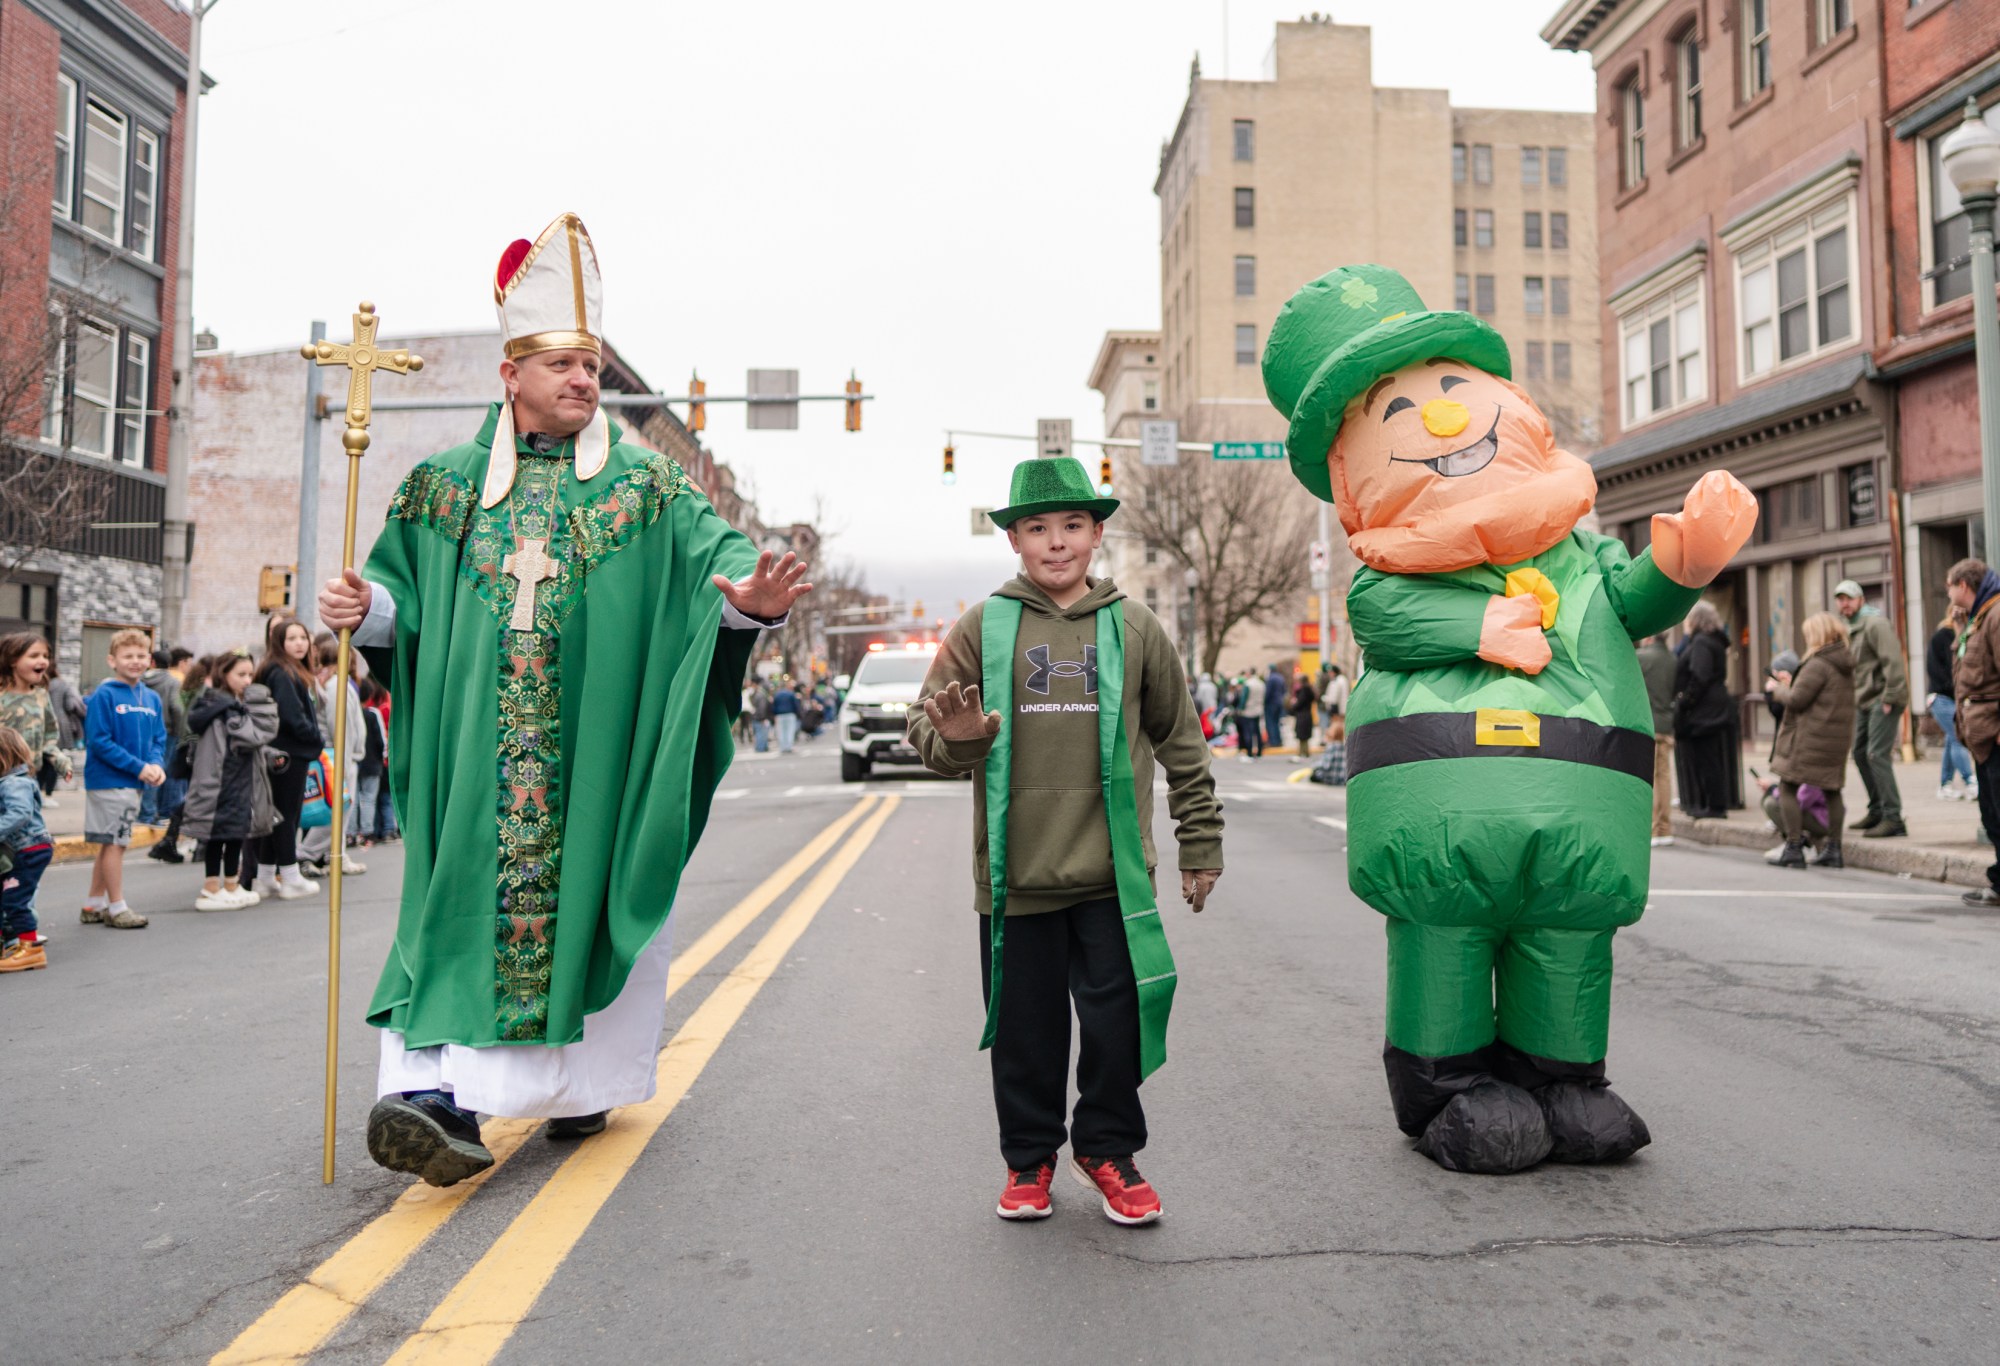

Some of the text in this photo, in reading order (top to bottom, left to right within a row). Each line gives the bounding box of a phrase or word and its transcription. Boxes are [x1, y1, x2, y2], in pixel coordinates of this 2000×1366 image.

[1217, 444, 1281, 457] Arch St
[1020, 703, 1061, 713] UNDER
